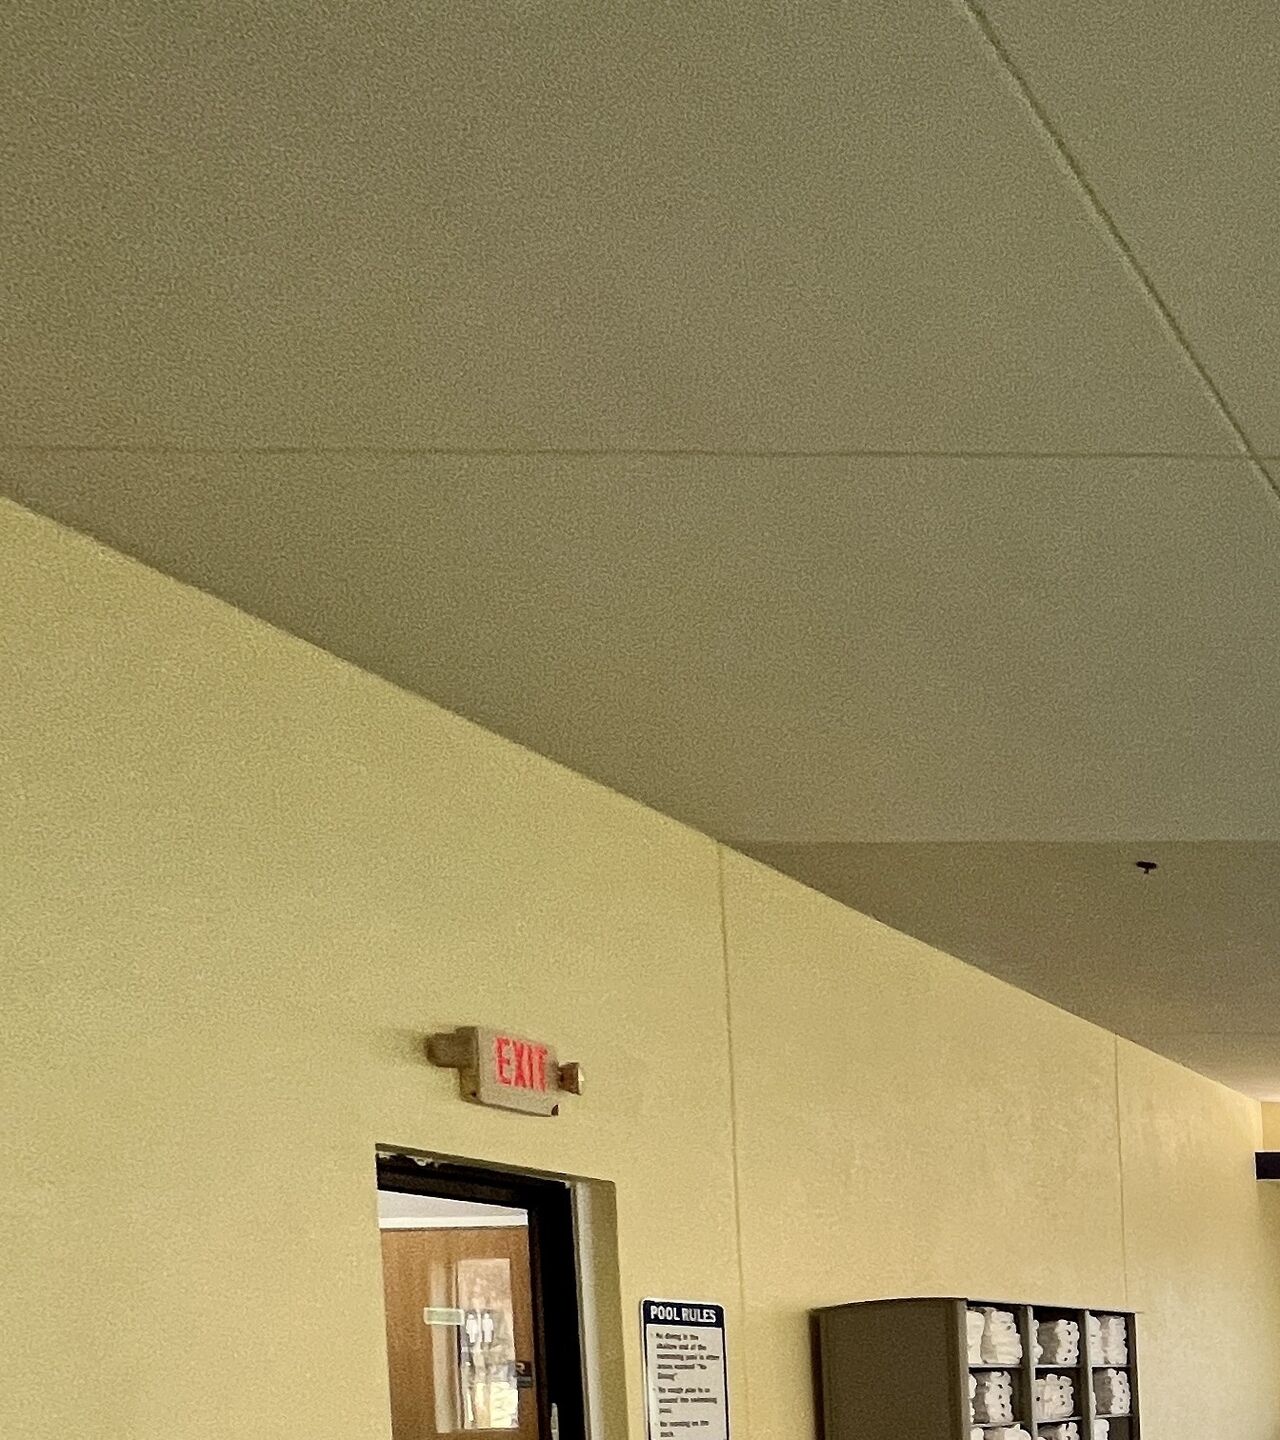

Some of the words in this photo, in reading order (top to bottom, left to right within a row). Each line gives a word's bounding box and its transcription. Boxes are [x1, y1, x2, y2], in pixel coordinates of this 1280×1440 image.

[496, 1038, 548, 1092] EXIT
[650, 1305, 680, 1320] POOL
[682, 1308, 716, 1323] RULES
